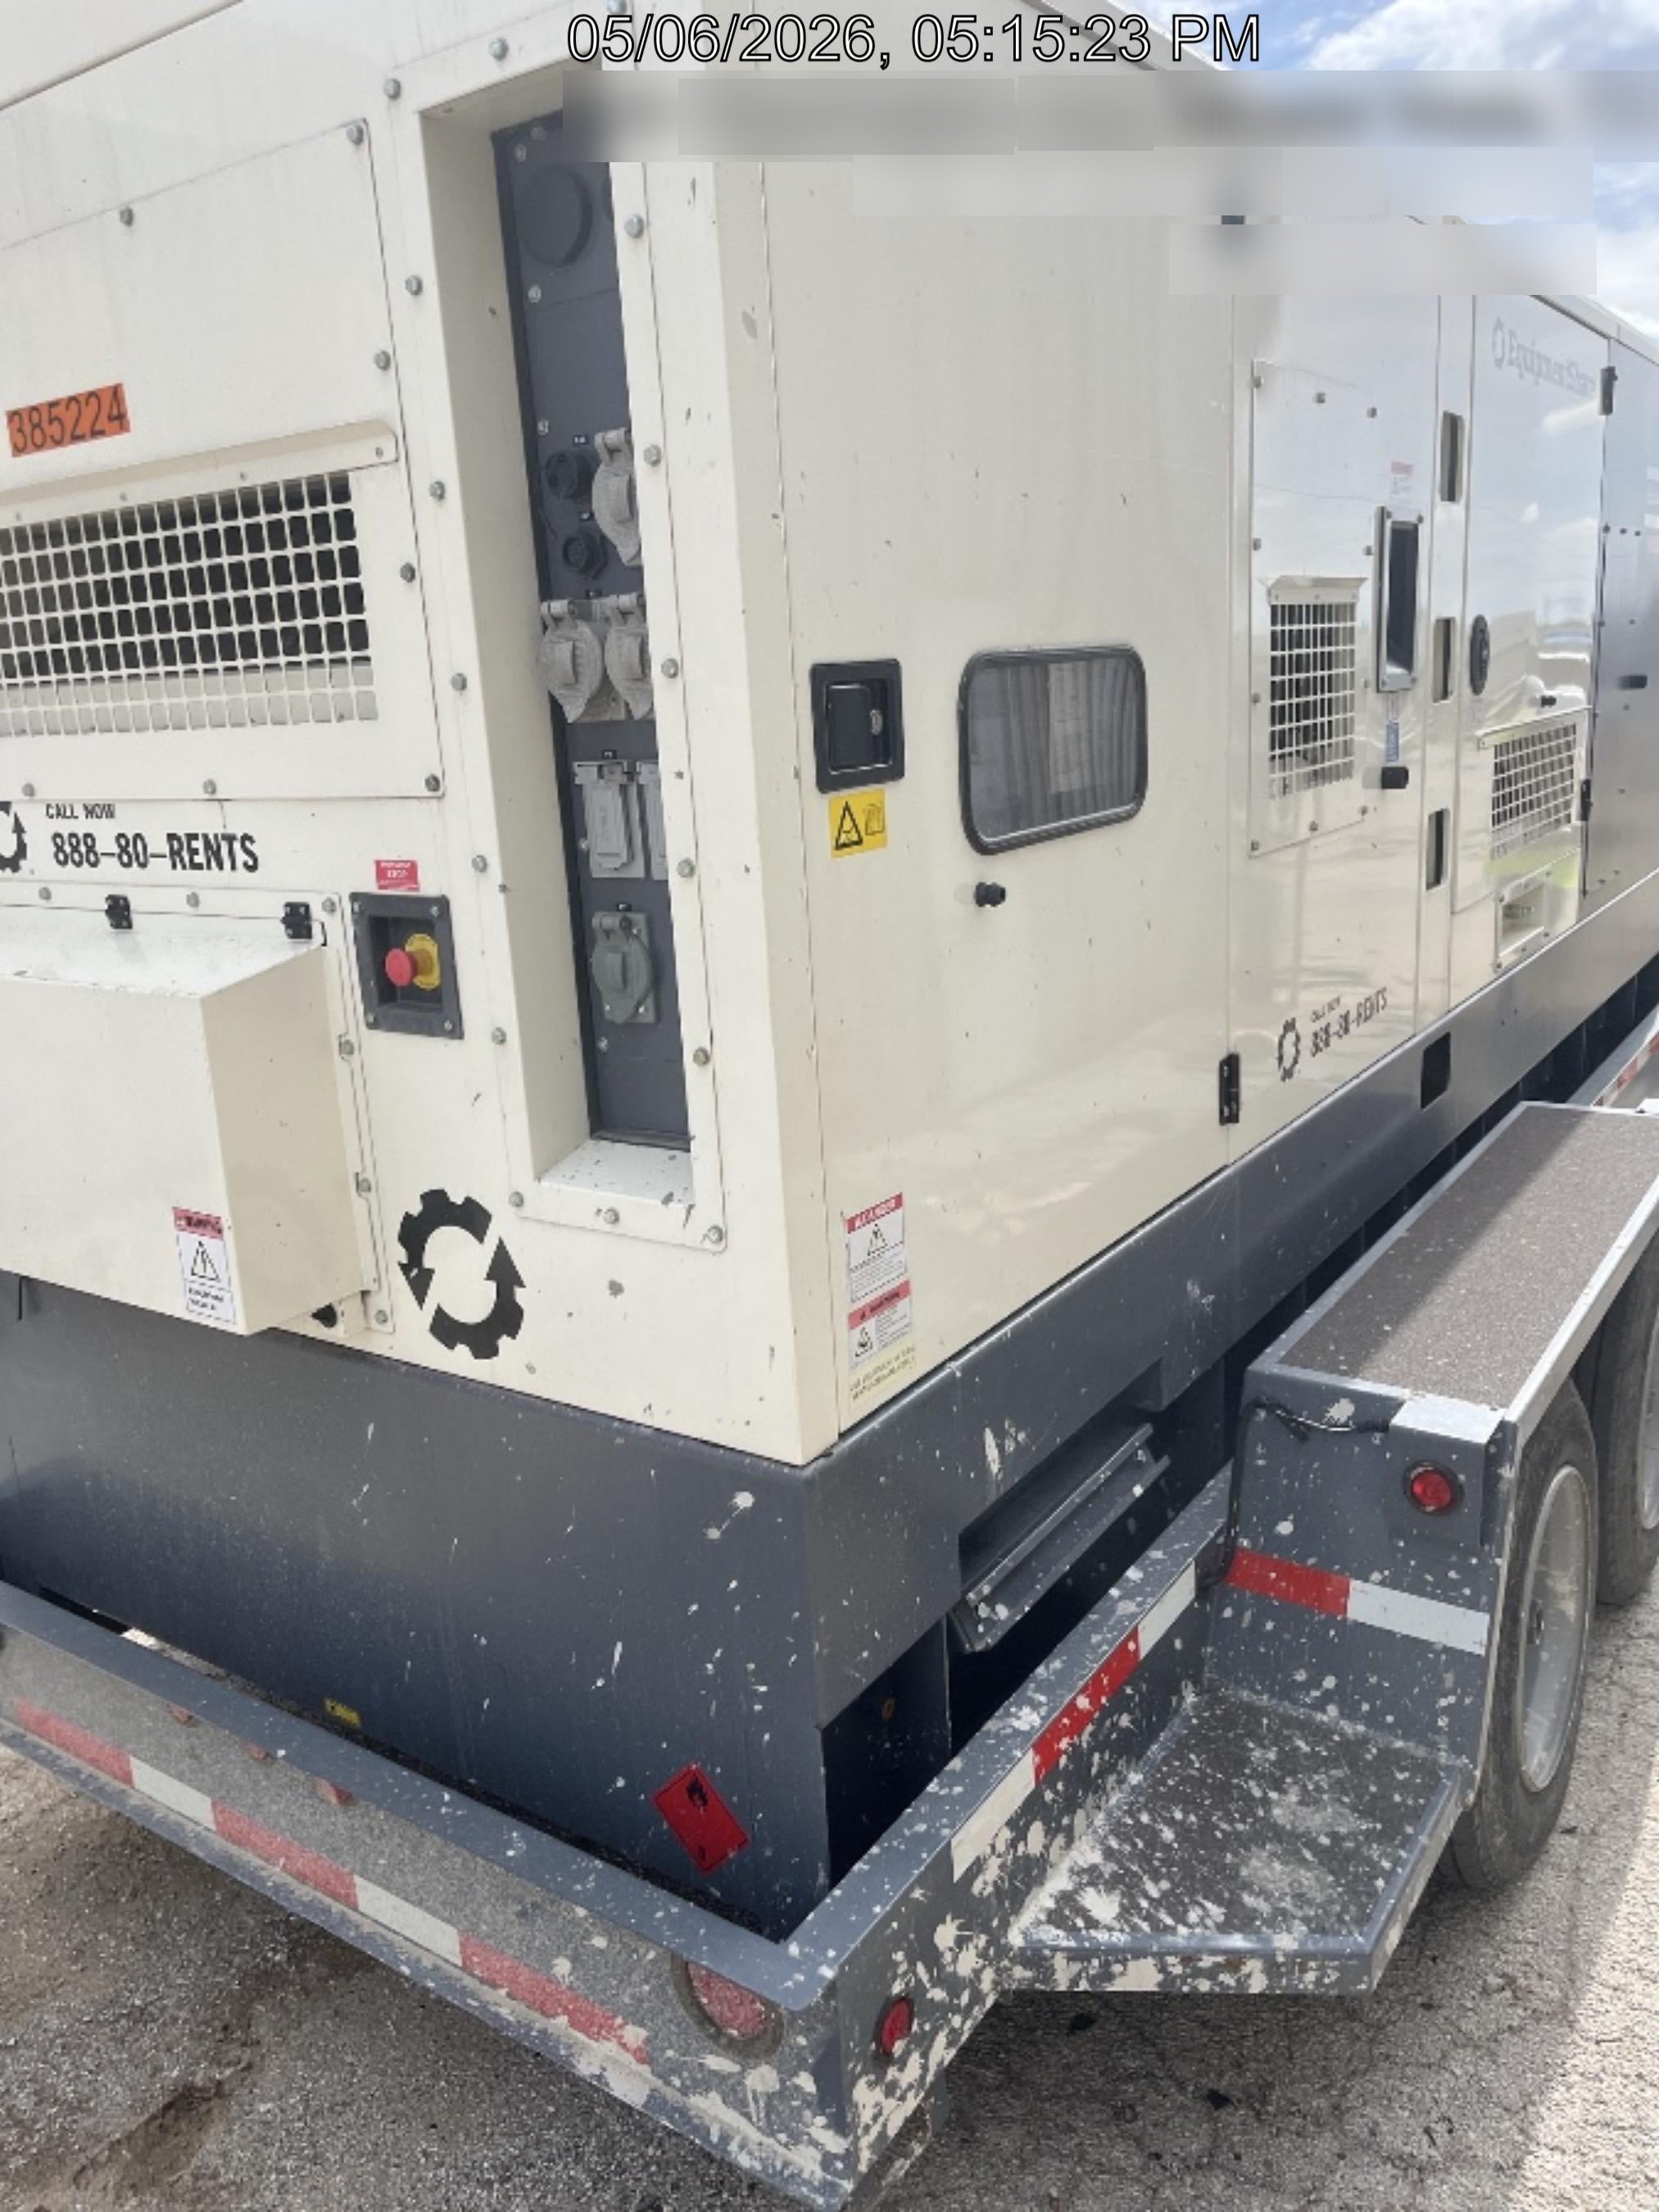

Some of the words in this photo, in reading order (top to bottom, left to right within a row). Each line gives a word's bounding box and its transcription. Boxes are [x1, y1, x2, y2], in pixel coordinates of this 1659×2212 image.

[9, 386, 126, 453] 385224
[45, 803, 79, 819] CALL
[83, 803, 116, 819] NOW
[51, 832, 260, 873] 888-80-RENTS
